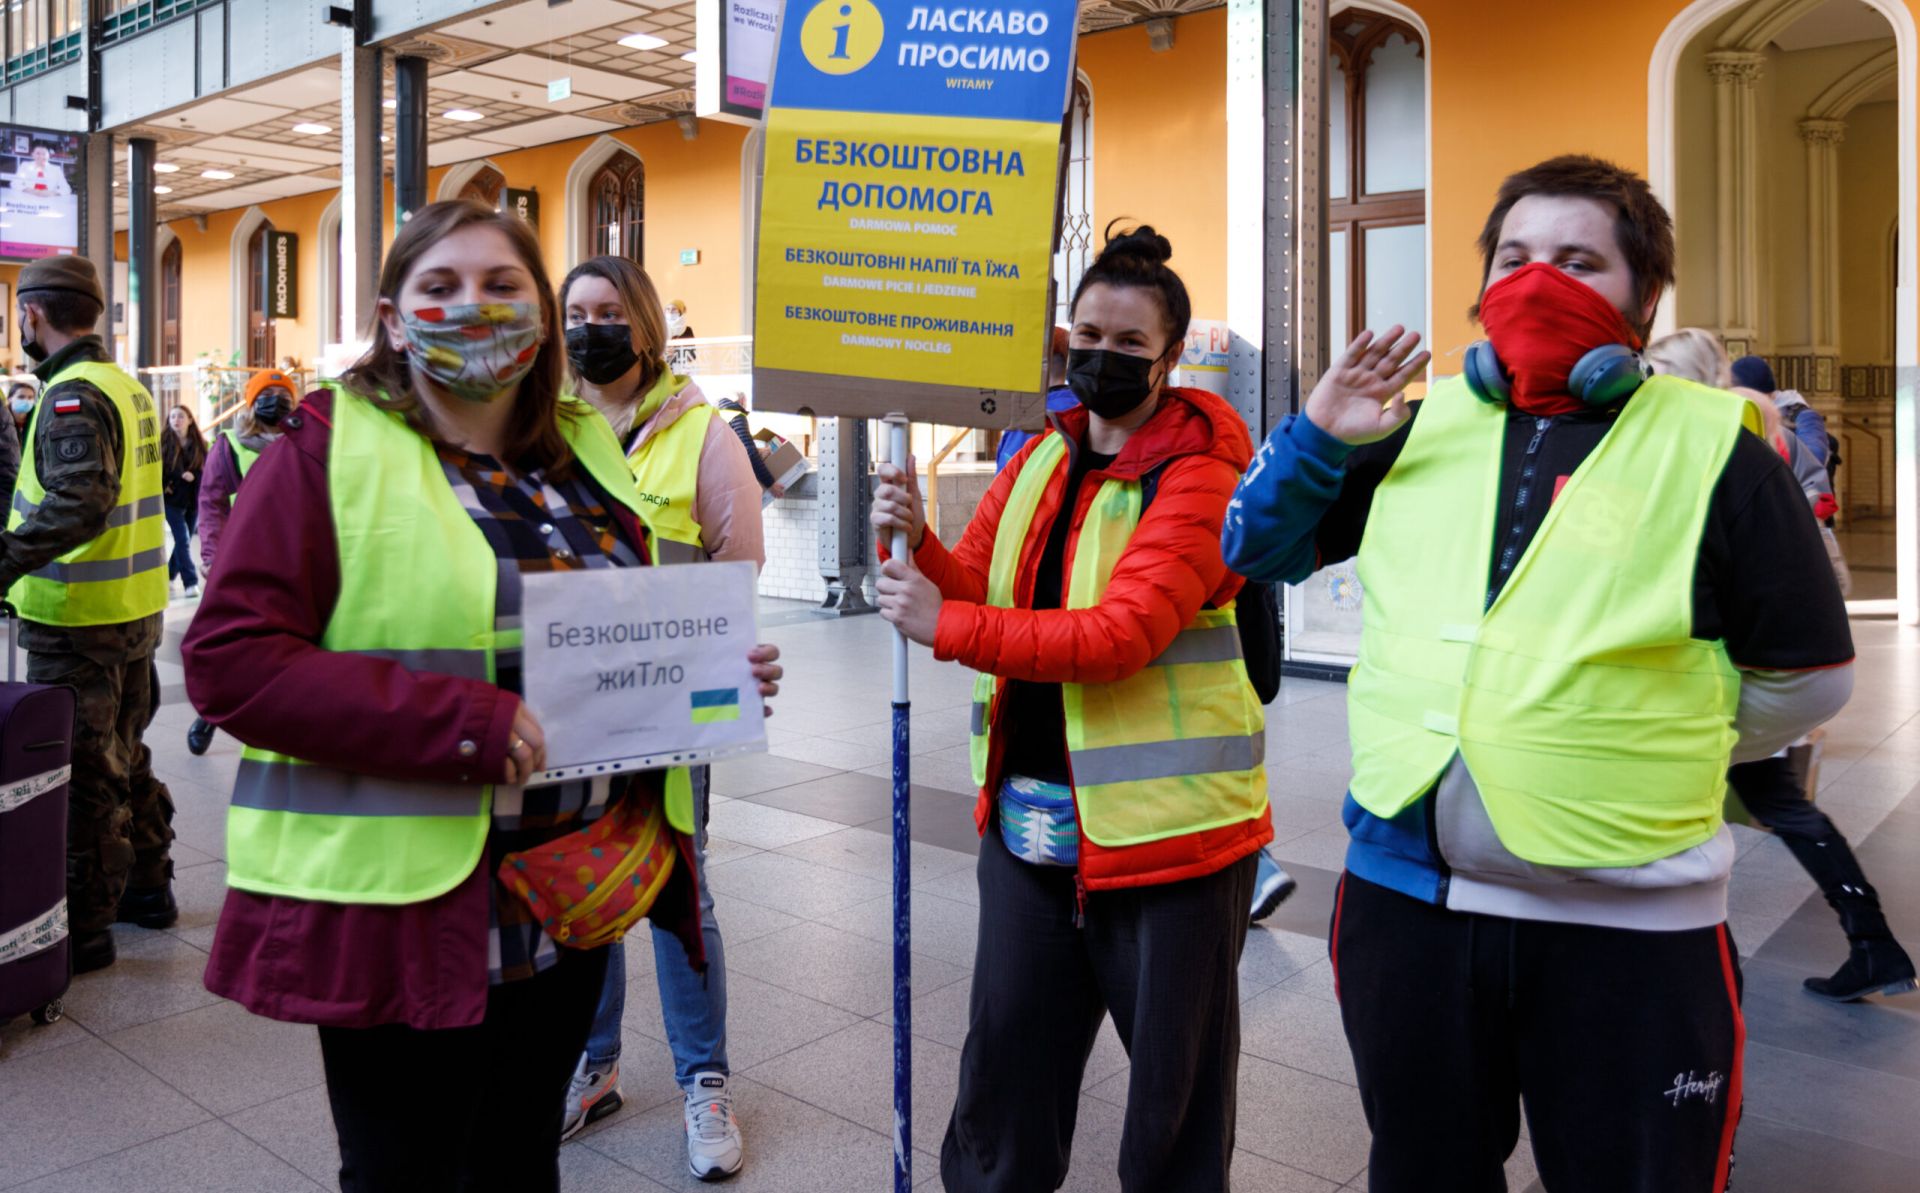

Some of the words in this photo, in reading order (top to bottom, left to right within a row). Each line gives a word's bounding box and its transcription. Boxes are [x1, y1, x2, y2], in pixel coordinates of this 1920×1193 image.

[906, 7, 1049, 36] ЛАСКАВО
[898, 42, 1050, 73] ПРОСИМО
[946, 77, 994, 90] WITAMY
[796, 138, 1025, 177] БЕЗКОШТОВНА
[817, 180, 994, 216] ДОПОМОГА
[849, 217, 912, 233] DARMOWA
[914, 220, 958, 236] POMOC
[276, 235, 287, 314] McDonald's
[785, 247, 906, 271] БЕЗКОШТОВНІ
[910, 255, 957, 275] НАПІЇ
[961, 260, 982, 277] ТА
[986, 260, 1020, 279] ЇЖА
[823, 275, 884, 292] DARMOWE
[886, 279, 914, 294] PICIE
[916, 281, 921, 294] I
[923, 282, 977, 298] JEDZENIE
[785, 305, 897, 328] БЕЗКОШТОВНЕ
[900, 315, 1014, 337] ПРОЖИВАННЯ
[841, 333, 902, 350] DARMOWY
[905, 339, 951, 354] NOCLEG
[547, 616, 729, 649] Безкоштовне
[596, 661, 684, 692] жиТло
